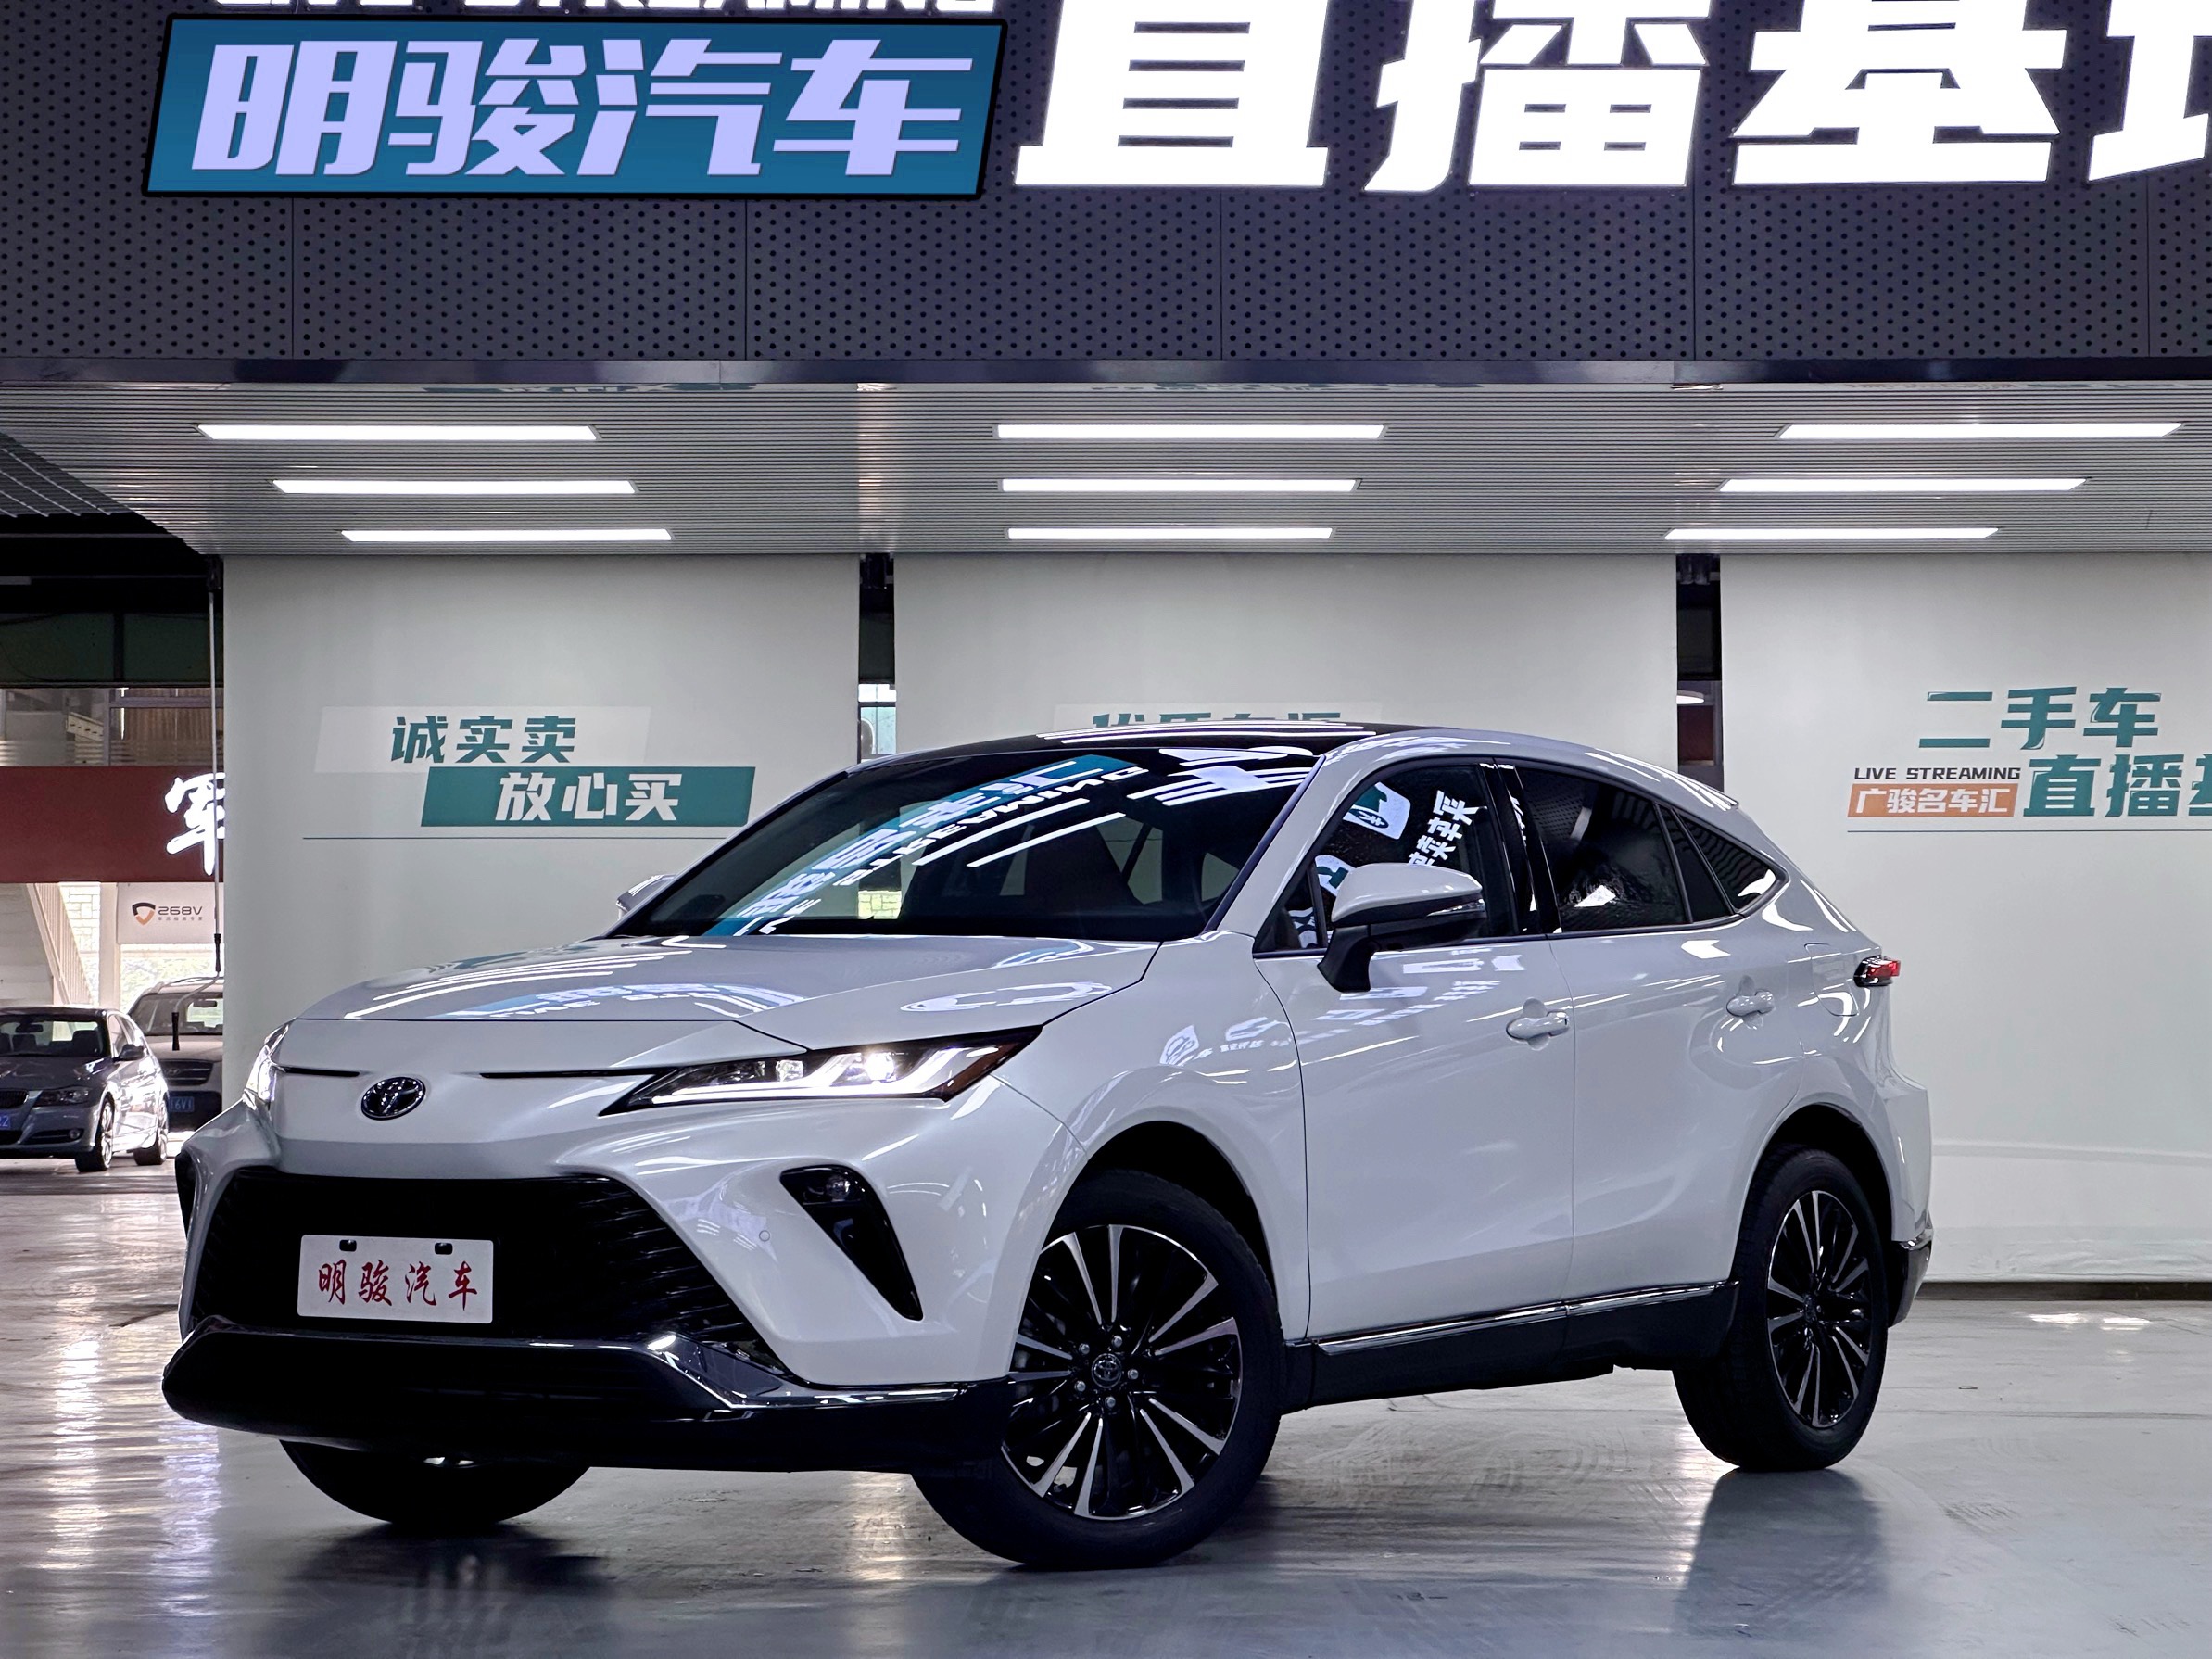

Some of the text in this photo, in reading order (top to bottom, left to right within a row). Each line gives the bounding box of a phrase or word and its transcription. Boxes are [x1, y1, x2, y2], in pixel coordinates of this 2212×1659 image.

[192, 38, 973, 176] 明骏汽车
[390, 716, 577, 764] 诚实卖
[1919, 687, 2162, 750] 二手车
[495, 772, 683, 822] 放心买
[1854, 767, 2021, 780] LIVE STREAMING
[1856, 788, 2008, 815] 广骏名车汇
[158, 905, 203, 916] 268V
[318, 1260, 477, 1311] 明骏汽车
